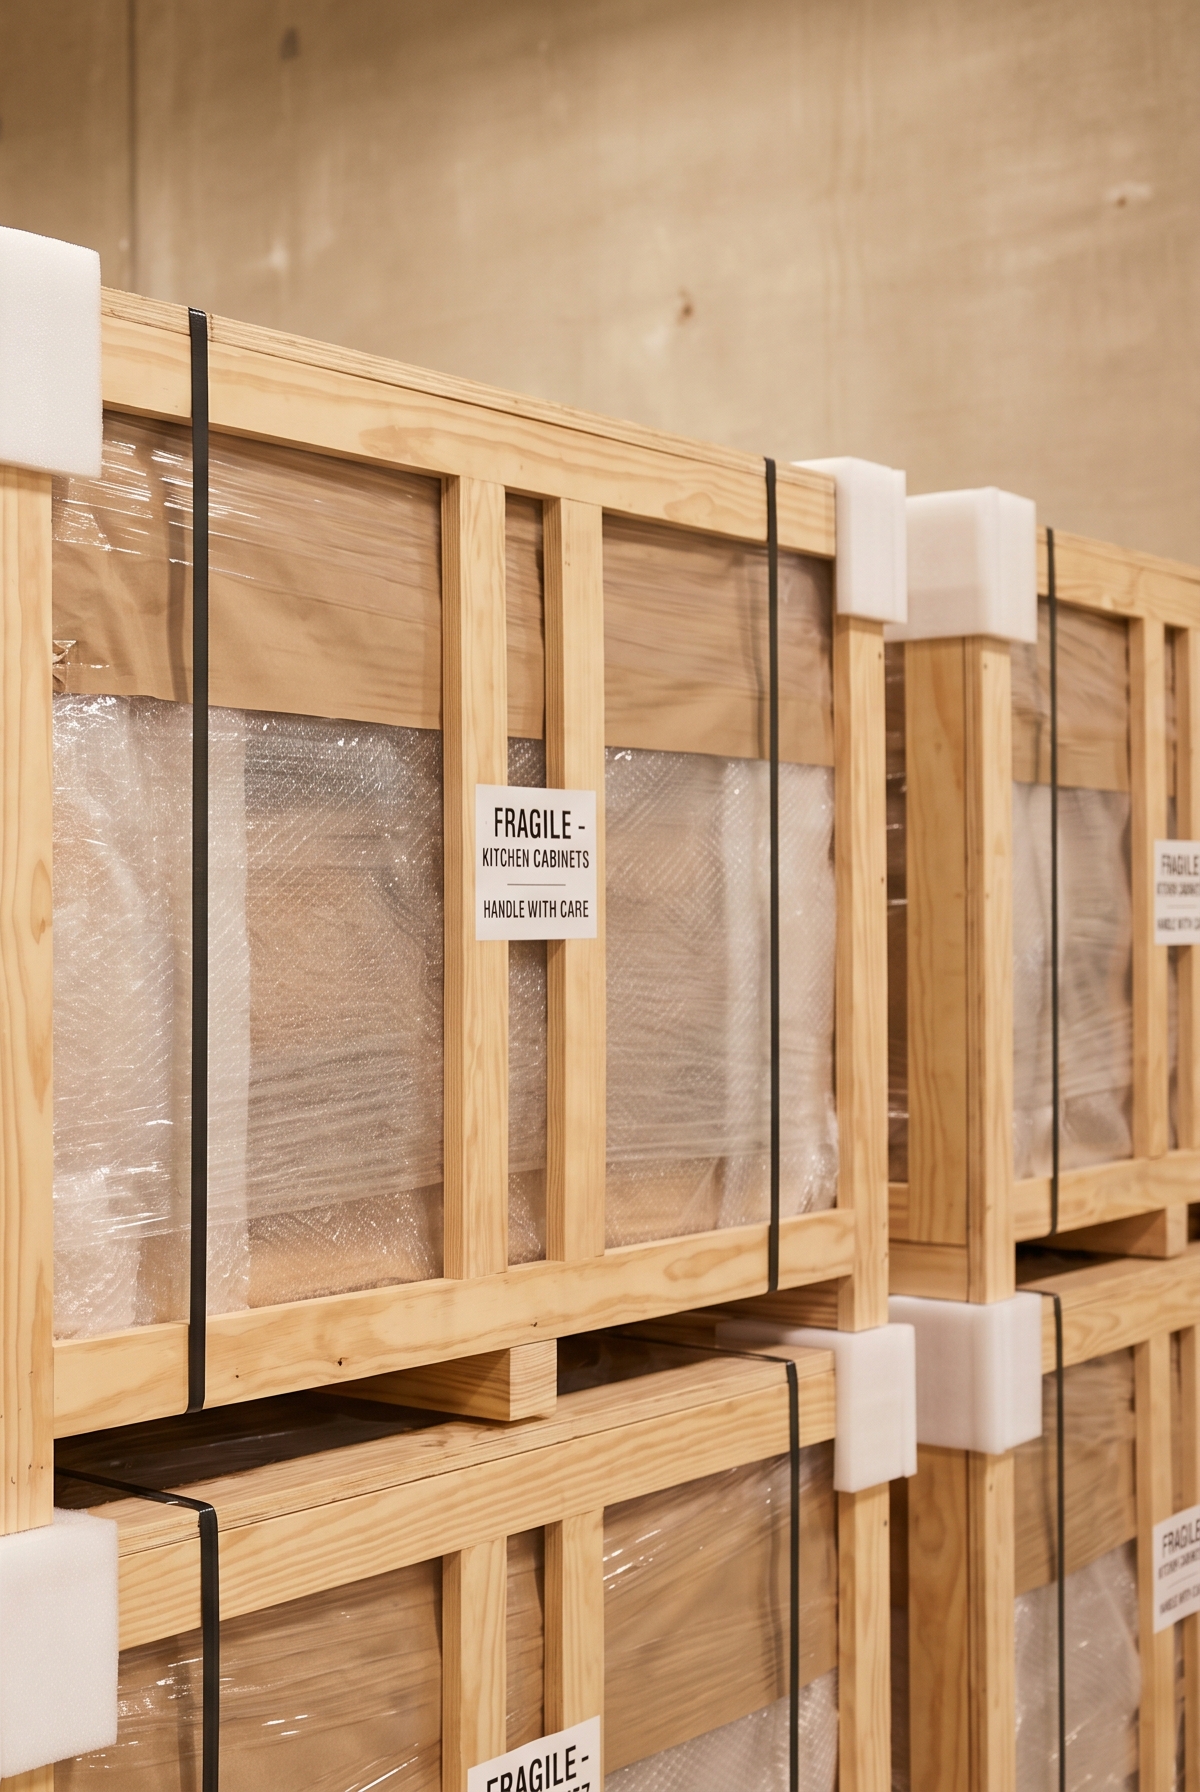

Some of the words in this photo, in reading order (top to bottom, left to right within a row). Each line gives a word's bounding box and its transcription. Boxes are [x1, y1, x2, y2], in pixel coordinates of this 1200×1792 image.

[494, 807, 572, 840] FRAGILE
[482, 847, 530, 868] KITCHEN
[533, 849, 590, 869] CABINETS
[483, 900, 525, 919] HANDLE
[528, 900, 557, 918] WITH
[560, 900, 589, 918] CARE
